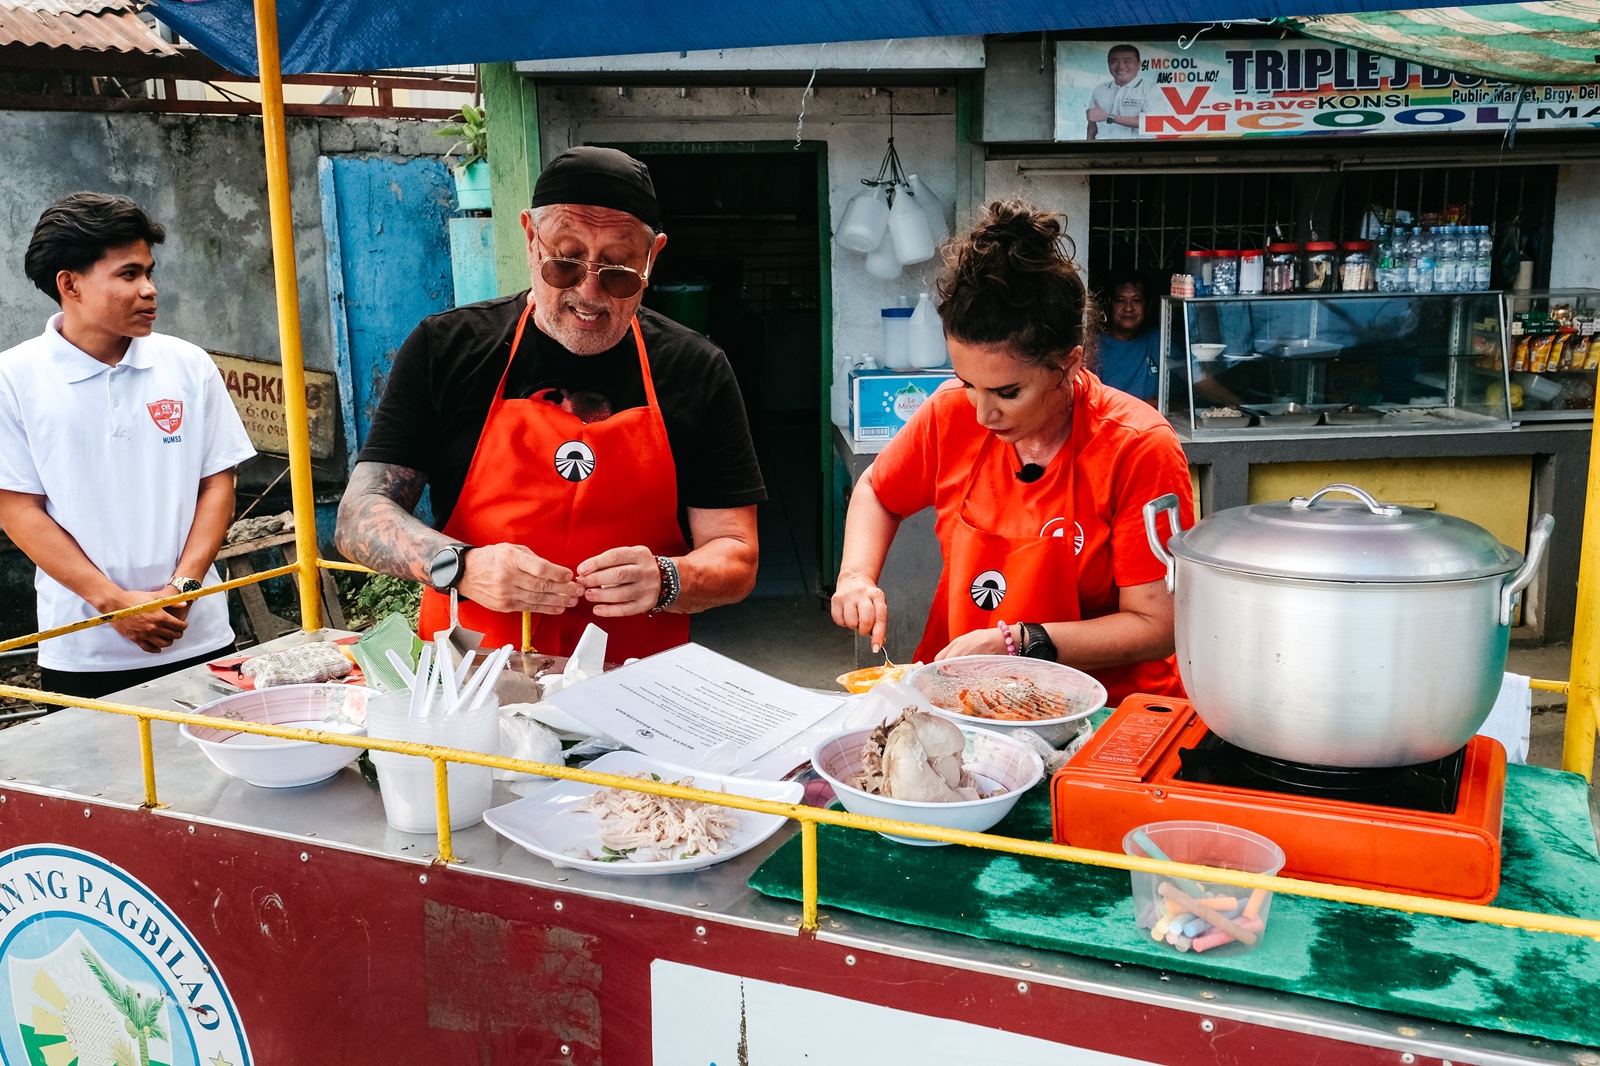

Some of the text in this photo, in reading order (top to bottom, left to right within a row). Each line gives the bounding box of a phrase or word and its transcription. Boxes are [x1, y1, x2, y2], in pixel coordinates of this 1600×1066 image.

[1141, 58, 1198, 71] SI MCOOL
[1225, 48, 1381, 94] TRIPLE
[1157, 70, 1219, 83] ANG IDOL KO!
[1453, 85, 1598, 104] Public Maret, Brgy. Del
[1145, 107, 1531, 132] MCOOL
[217, 368, 321, 410] ARKIG
[163, 435, 181, 444] HUMSS
[24, 870, 68, 900] NG
[77, 874, 220, 1031] PAGBILAO
